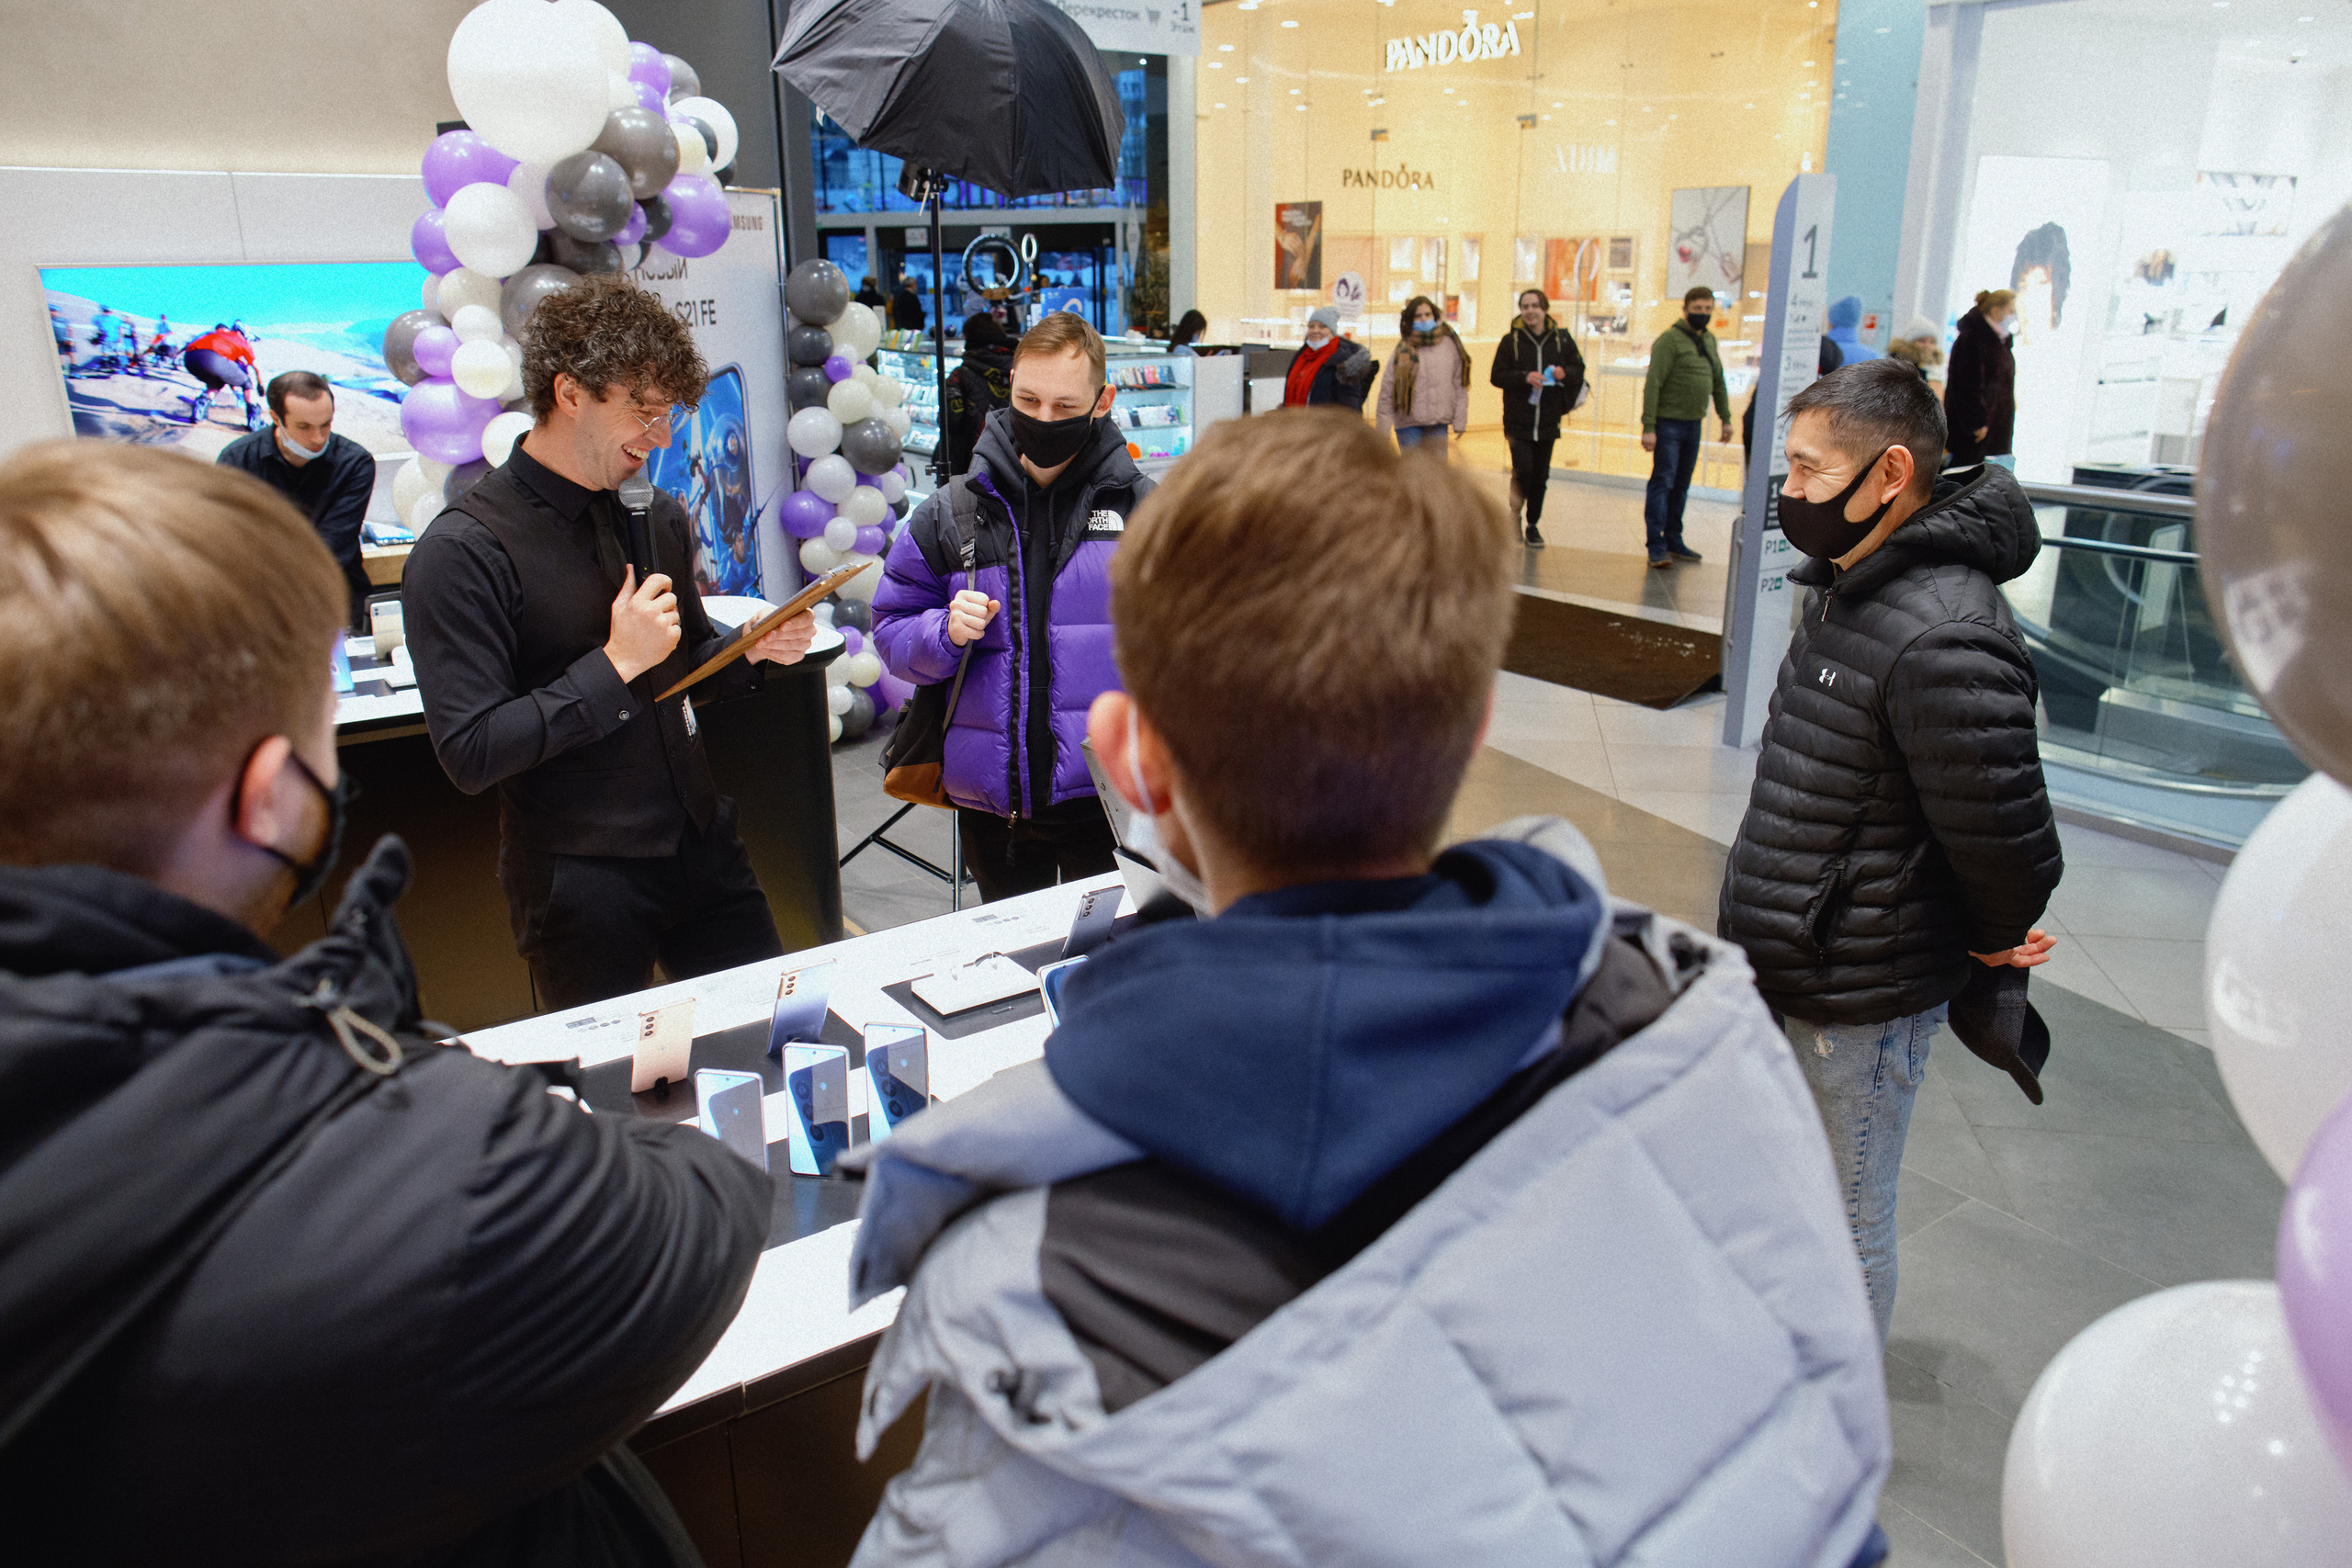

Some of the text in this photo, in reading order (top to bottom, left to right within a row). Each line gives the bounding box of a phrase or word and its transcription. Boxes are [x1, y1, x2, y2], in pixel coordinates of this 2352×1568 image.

[1172, 2, 1190, 21] -1
[1385, 9, 1521, 73] PANDORA
[1342, 163, 1435, 190] PANDORA
[729, 215, 763, 231] MSUNG
[1802, 223, 1818, 279] 1
[700, 299, 717, 326] FE
[1087, 516, 1108, 525] ORTH
